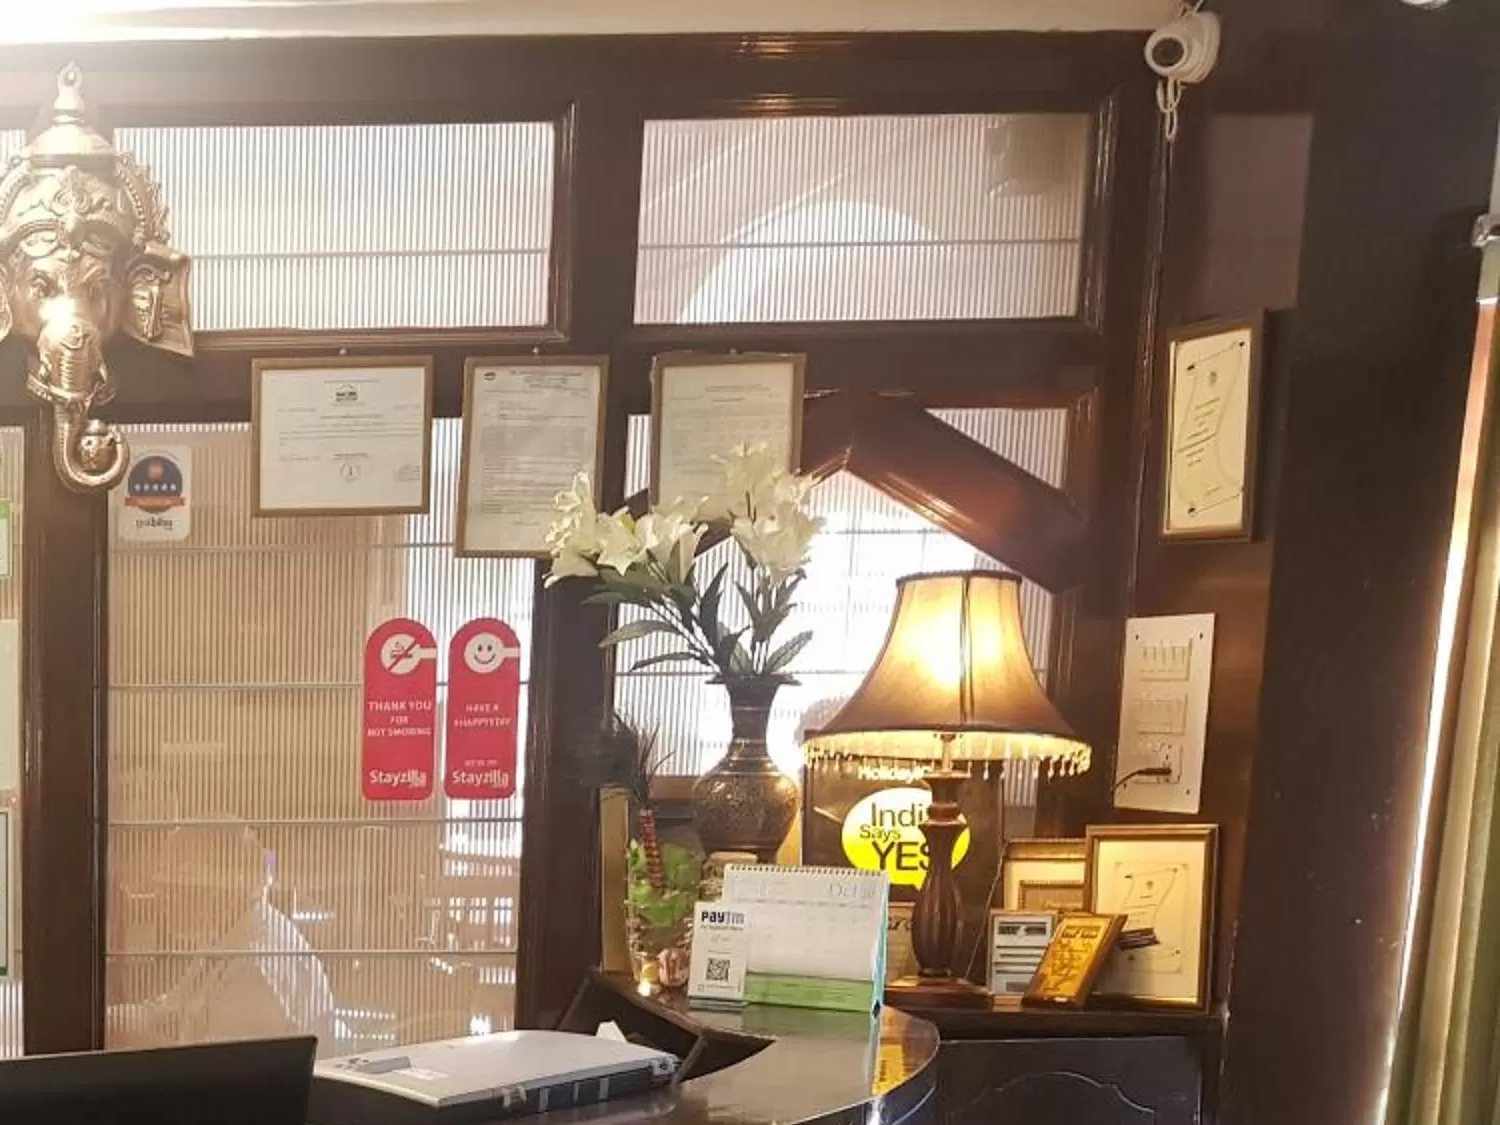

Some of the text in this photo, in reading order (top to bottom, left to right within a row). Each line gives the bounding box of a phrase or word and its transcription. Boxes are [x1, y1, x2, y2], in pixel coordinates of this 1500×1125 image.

[367, 701, 432, 711] THANK YOU
[367, 727, 386, 737] NOT
[369, 769, 427, 787] Stayzilla
[452, 769, 510, 788] Stayzilla
[871, 801, 926, 827] Indi
[860, 823, 901, 842] Says
